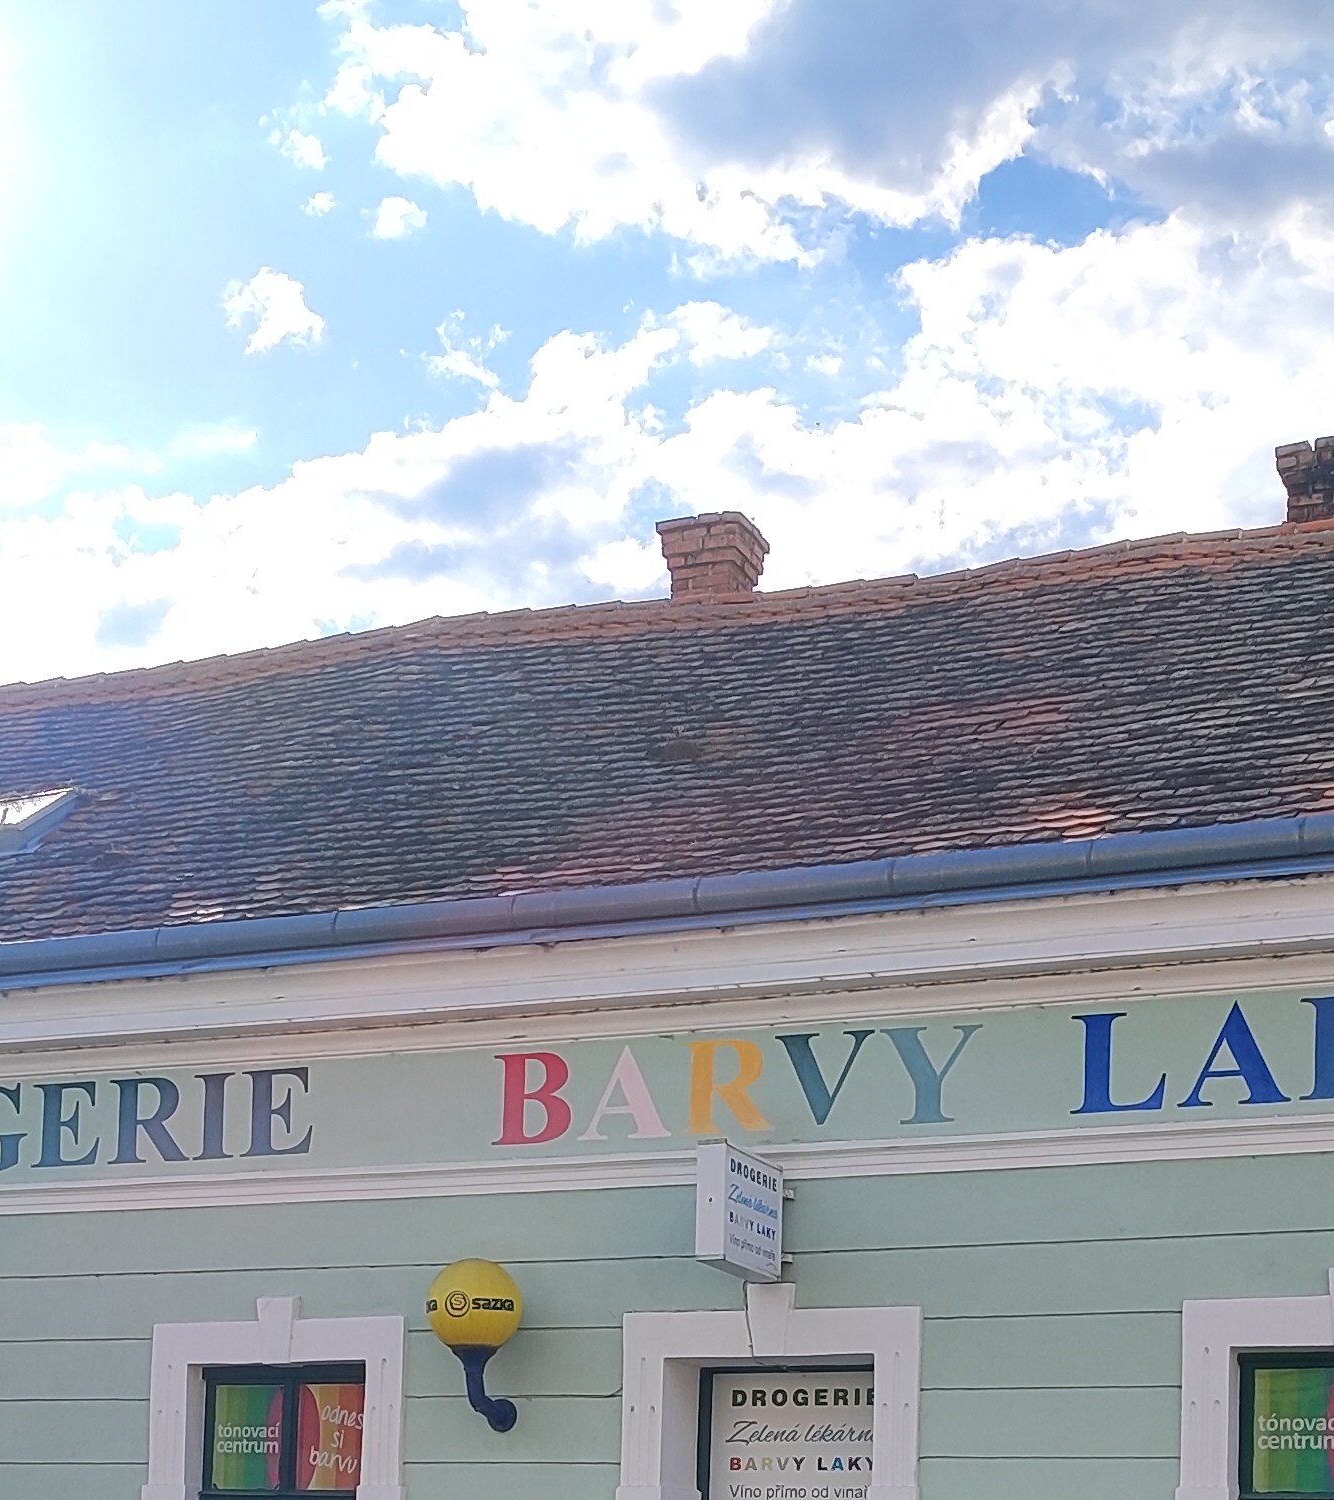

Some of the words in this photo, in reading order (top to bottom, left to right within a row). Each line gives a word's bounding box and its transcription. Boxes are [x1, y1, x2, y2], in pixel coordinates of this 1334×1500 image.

[490, 1023, 983, 1147] BARVY
[730, 1158, 778, 1192] DROGERIE
[756, 1222, 777, 1241] LAKY
[471, 1297, 515, 1312] sazka
[321, 1405, 364, 1431] odnes
[217, 1421, 280, 1438] tónovací
[725, 1420, 802, 1446] Zelená
[216, 1438, 279, 1454] centrum
[330, 1430, 345, 1449] si
[309, 1445, 358, 1474] barvu
[729, 1456, 806, 1472] BARVY
[729, 1484, 763, 1499] Víno
[811, 1484, 829, 1499] od
